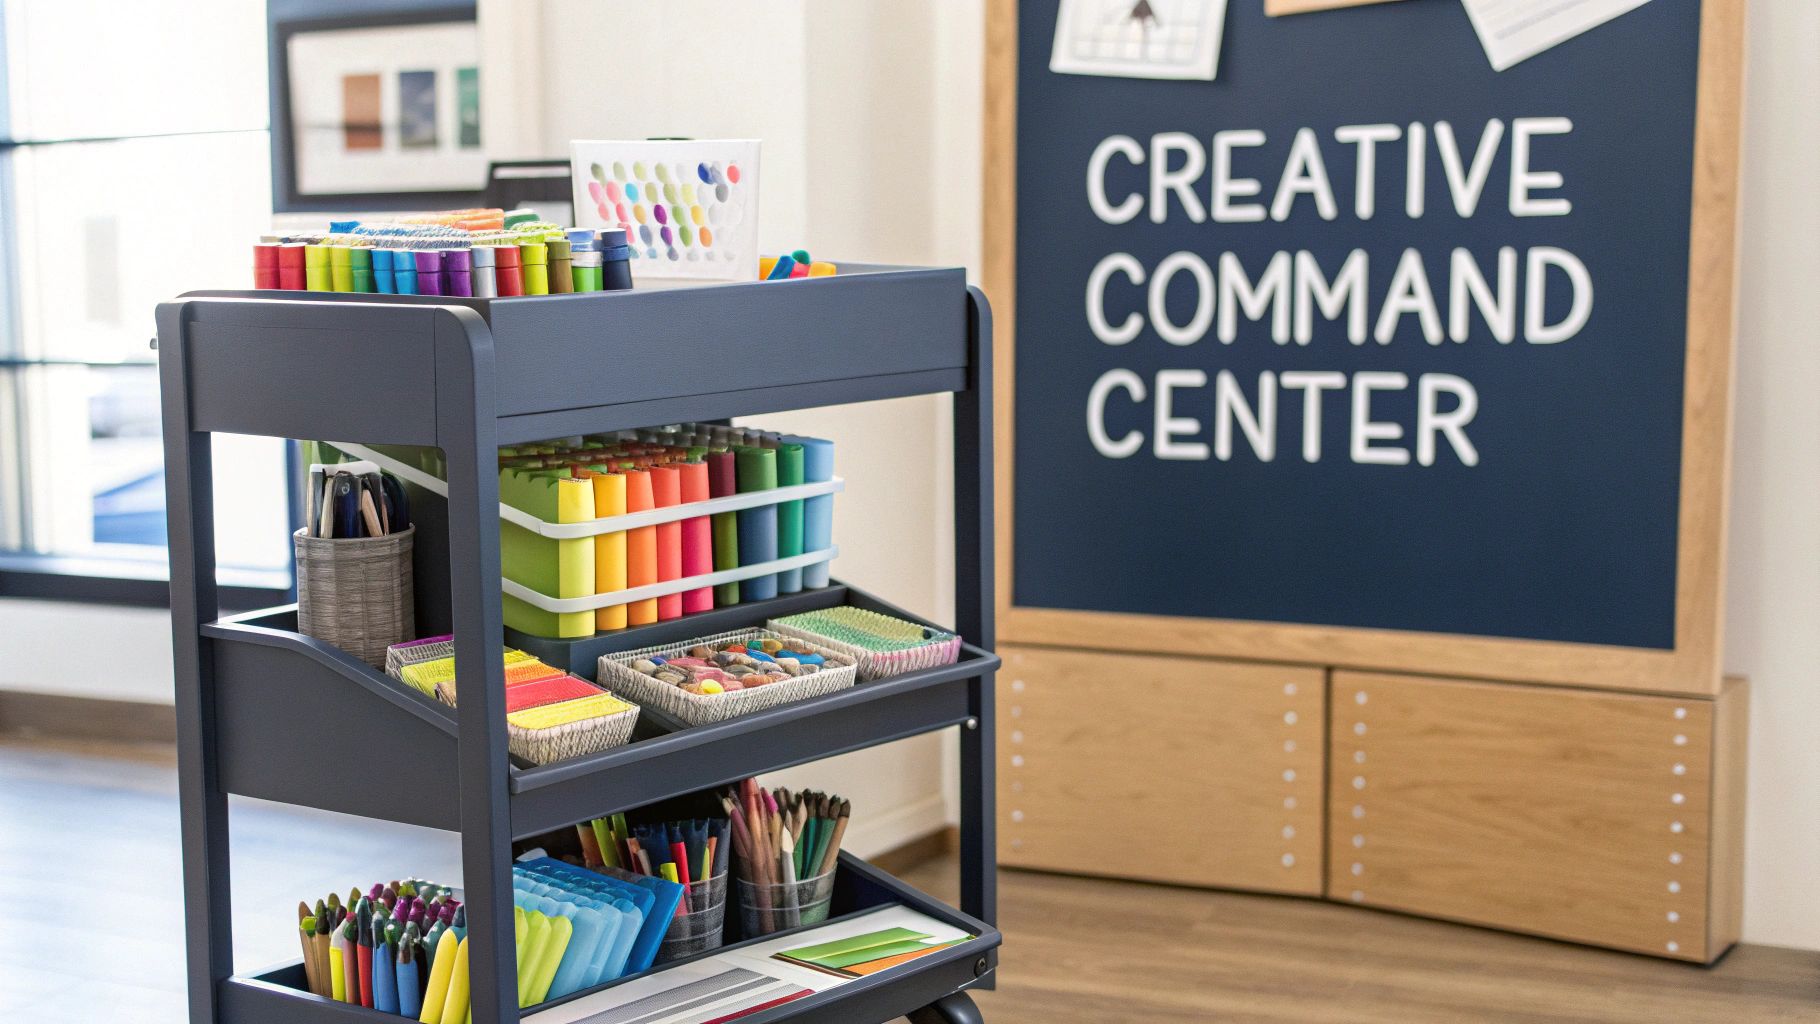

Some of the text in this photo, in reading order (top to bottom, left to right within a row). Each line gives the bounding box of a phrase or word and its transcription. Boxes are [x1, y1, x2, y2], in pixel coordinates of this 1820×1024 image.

[1086, 116, 1573, 224] CREATIVE
[1085, 246, 1593, 345] COMMAND
[1086, 369, 1479, 467] CENTER
